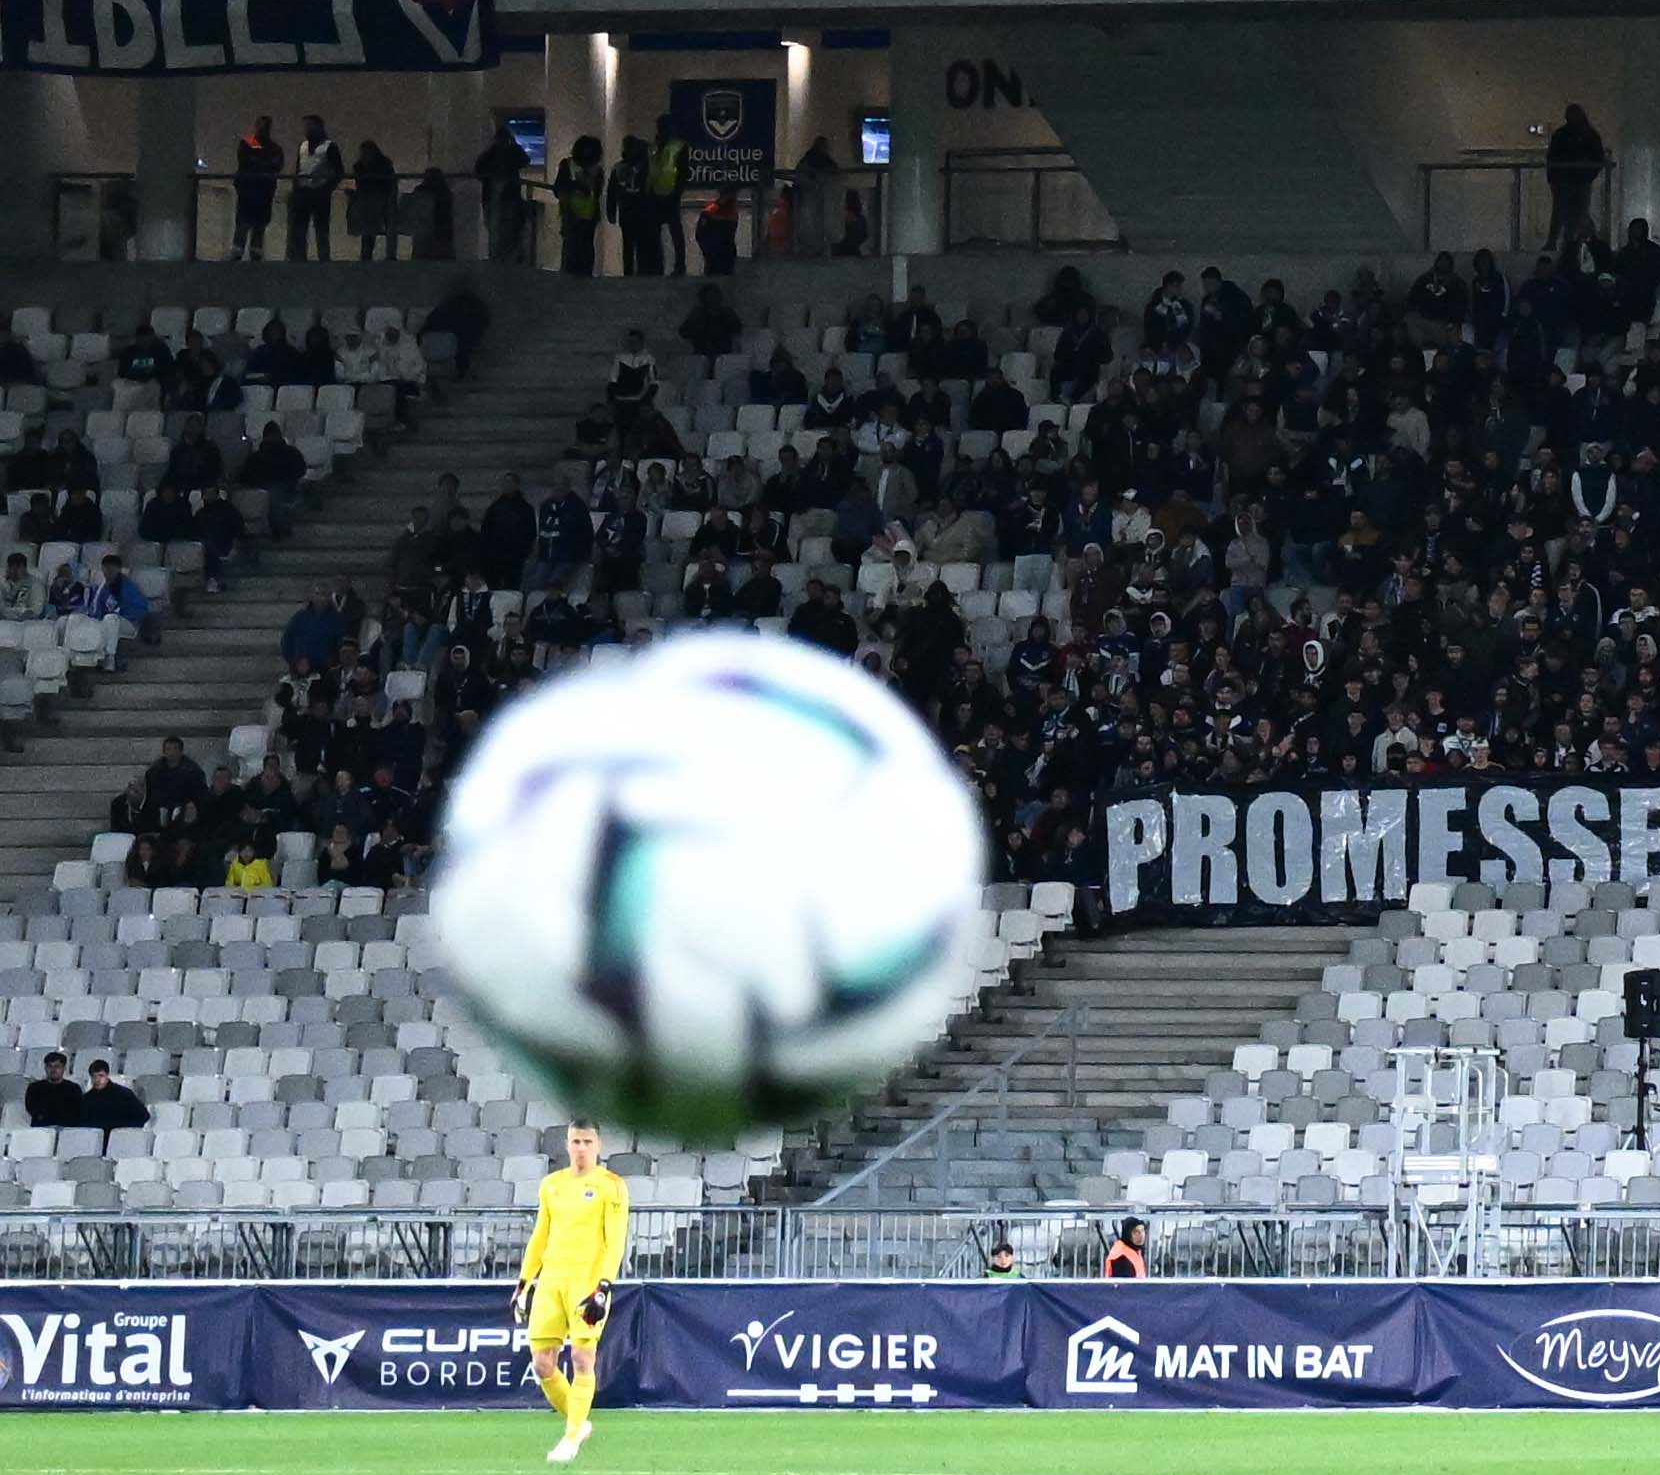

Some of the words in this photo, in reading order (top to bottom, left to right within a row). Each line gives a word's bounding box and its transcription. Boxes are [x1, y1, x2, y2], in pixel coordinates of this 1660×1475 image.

[113, 1312, 168, 1330] Groupe
[0, 1313, 192, 1386] Vital
[773, 1333, 938, 1369] VIGIER
[1154, 1344, 1238, 1379] MAT
[1247, 1344, 1284, 1379] IN
[1295, 1344, 1374, 1379] BAT
[115, 1388, 191, 1402] d'entreprise
